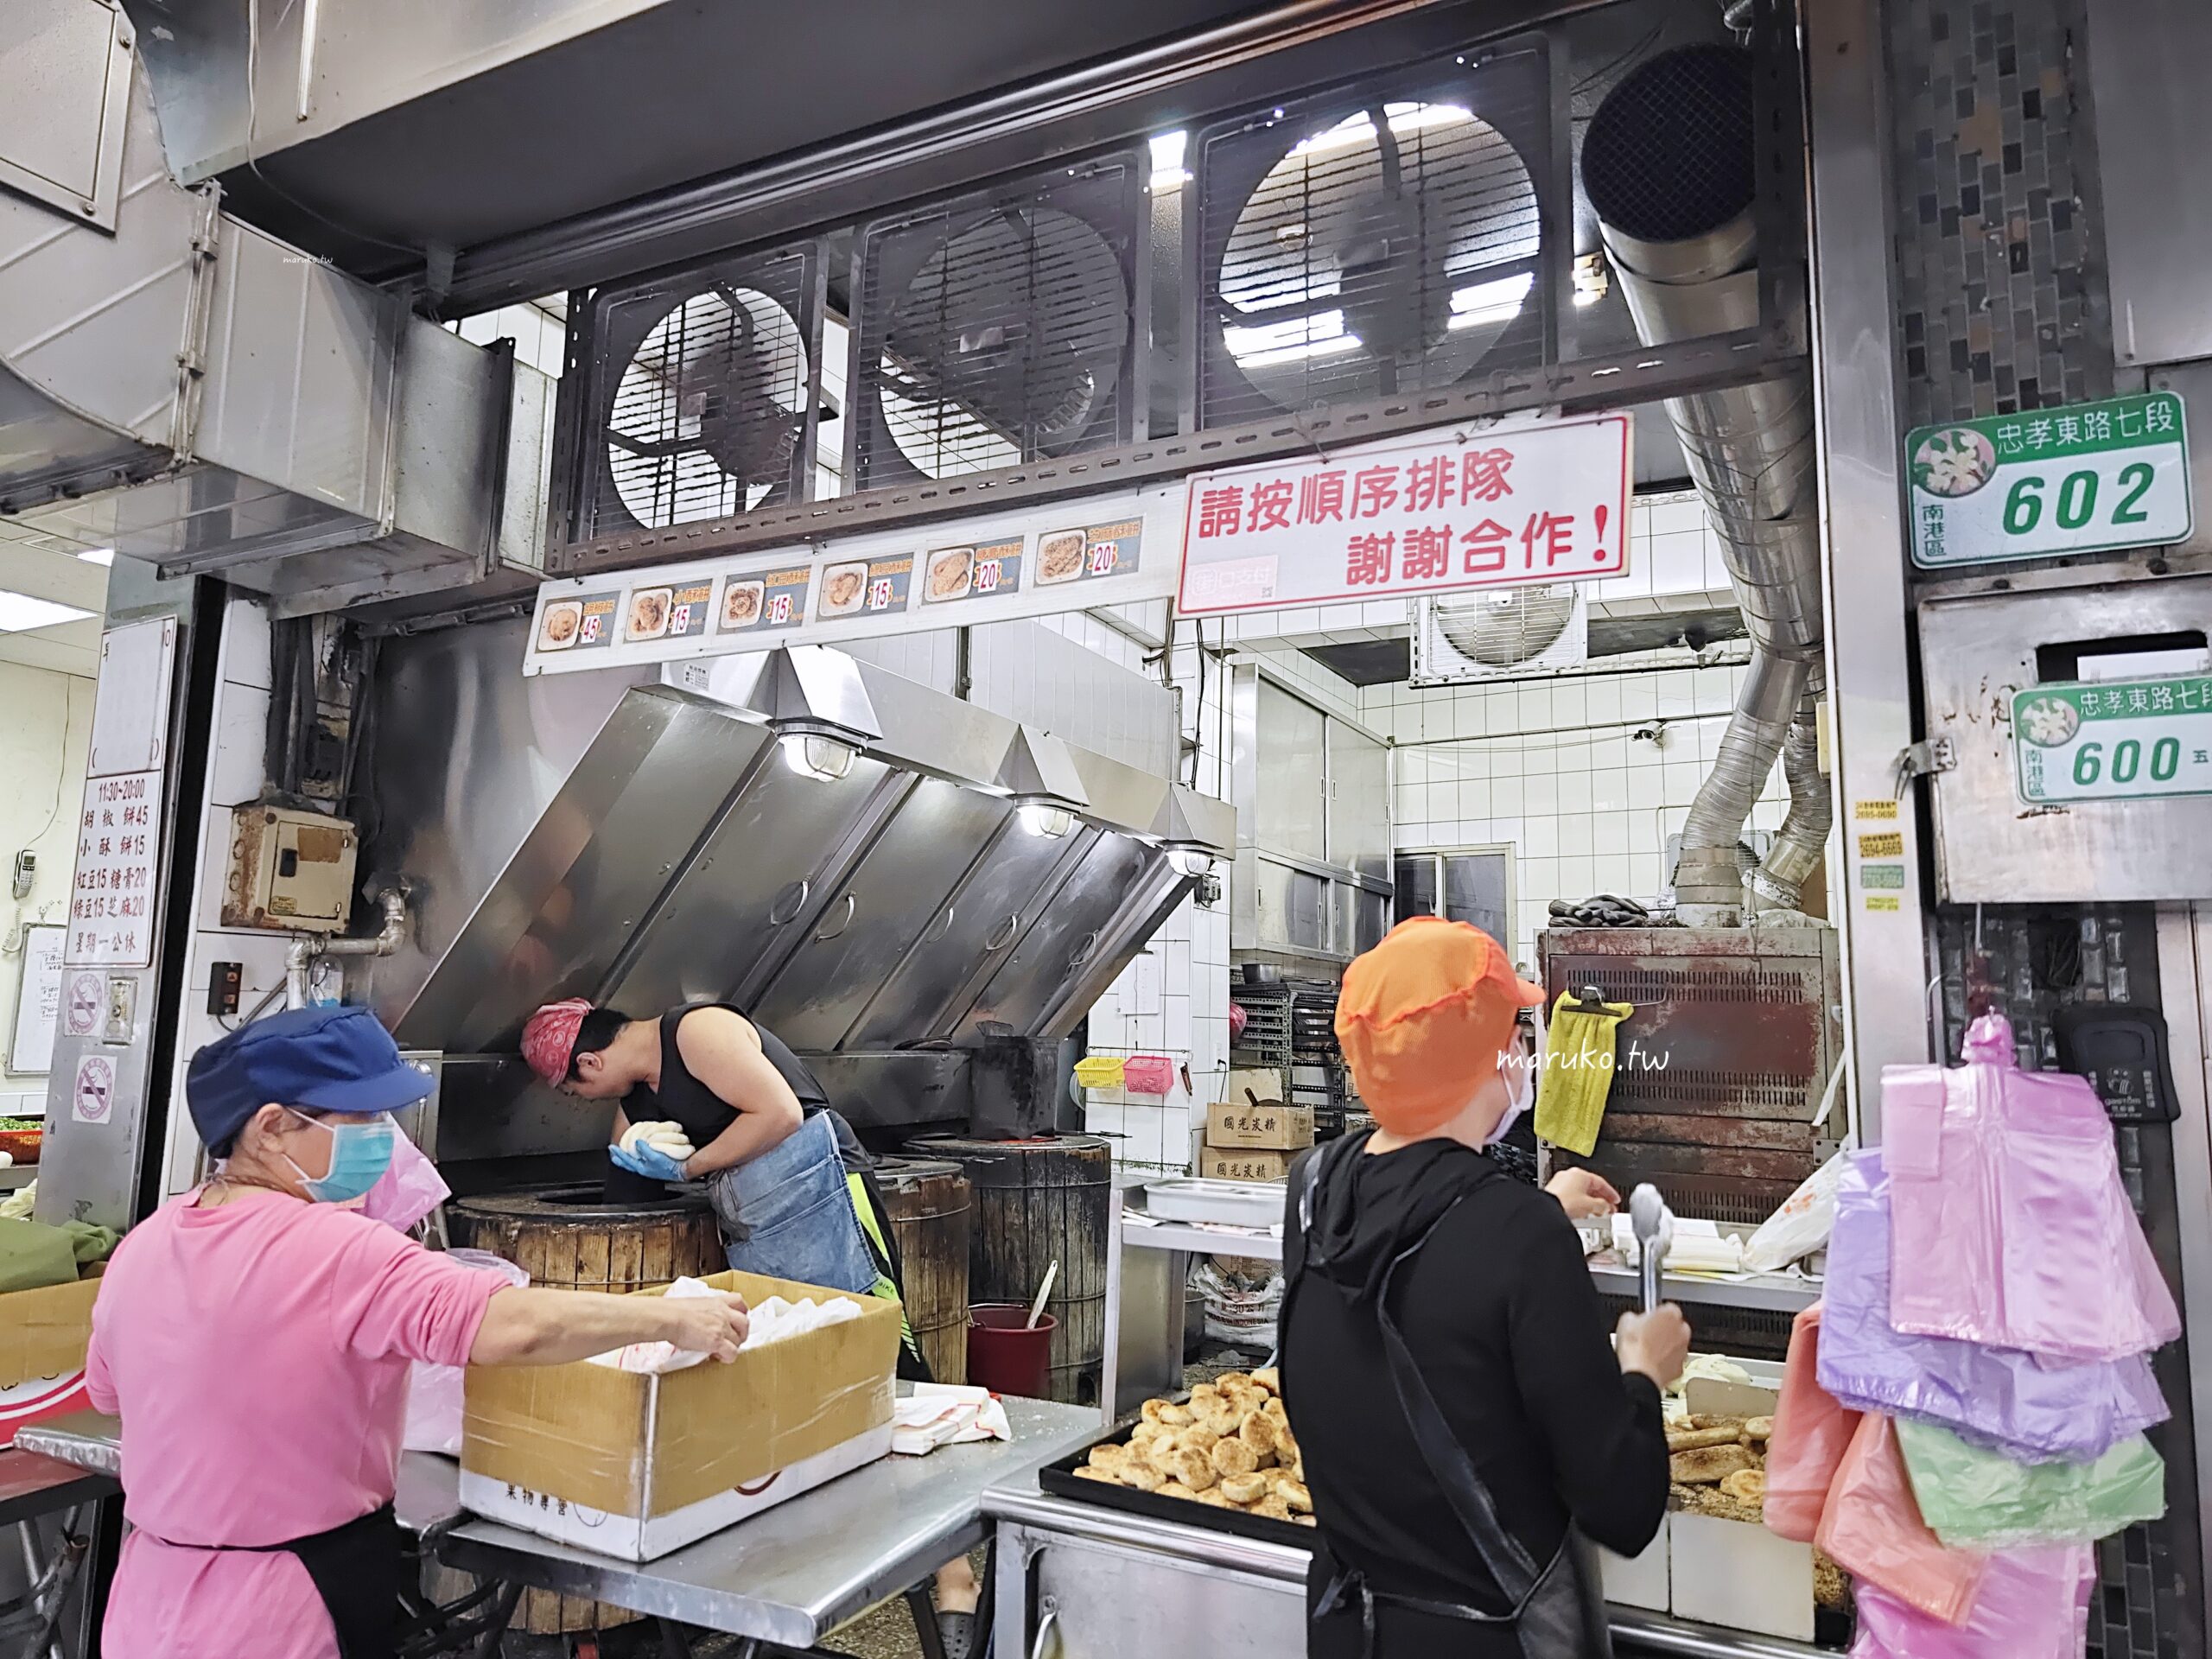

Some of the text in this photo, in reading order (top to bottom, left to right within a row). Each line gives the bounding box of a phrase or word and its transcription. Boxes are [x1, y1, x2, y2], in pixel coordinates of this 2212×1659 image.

[1997, 400, 2175, 455] 忠孝東路七段
[1198, 448, 1514, 538] 請按順序排隊
[2003, 462, 2154, 536] 602
[1923, 505, 1947, 557] 南港區
[1094, 545, 1110, 571] 20
[1346, 505, 1608, 586] 謝謝合作!
[981, 563, 995, 588] 20
[874, 582, 887, 606] 15
[676, 608, 688, 631] 15
[775, 597, 787, 620] 15
[583, 618, 598, 639] 45
[2073, 737, 2180, 785] 600
[74, 931, 137, 954] 星期一公休
